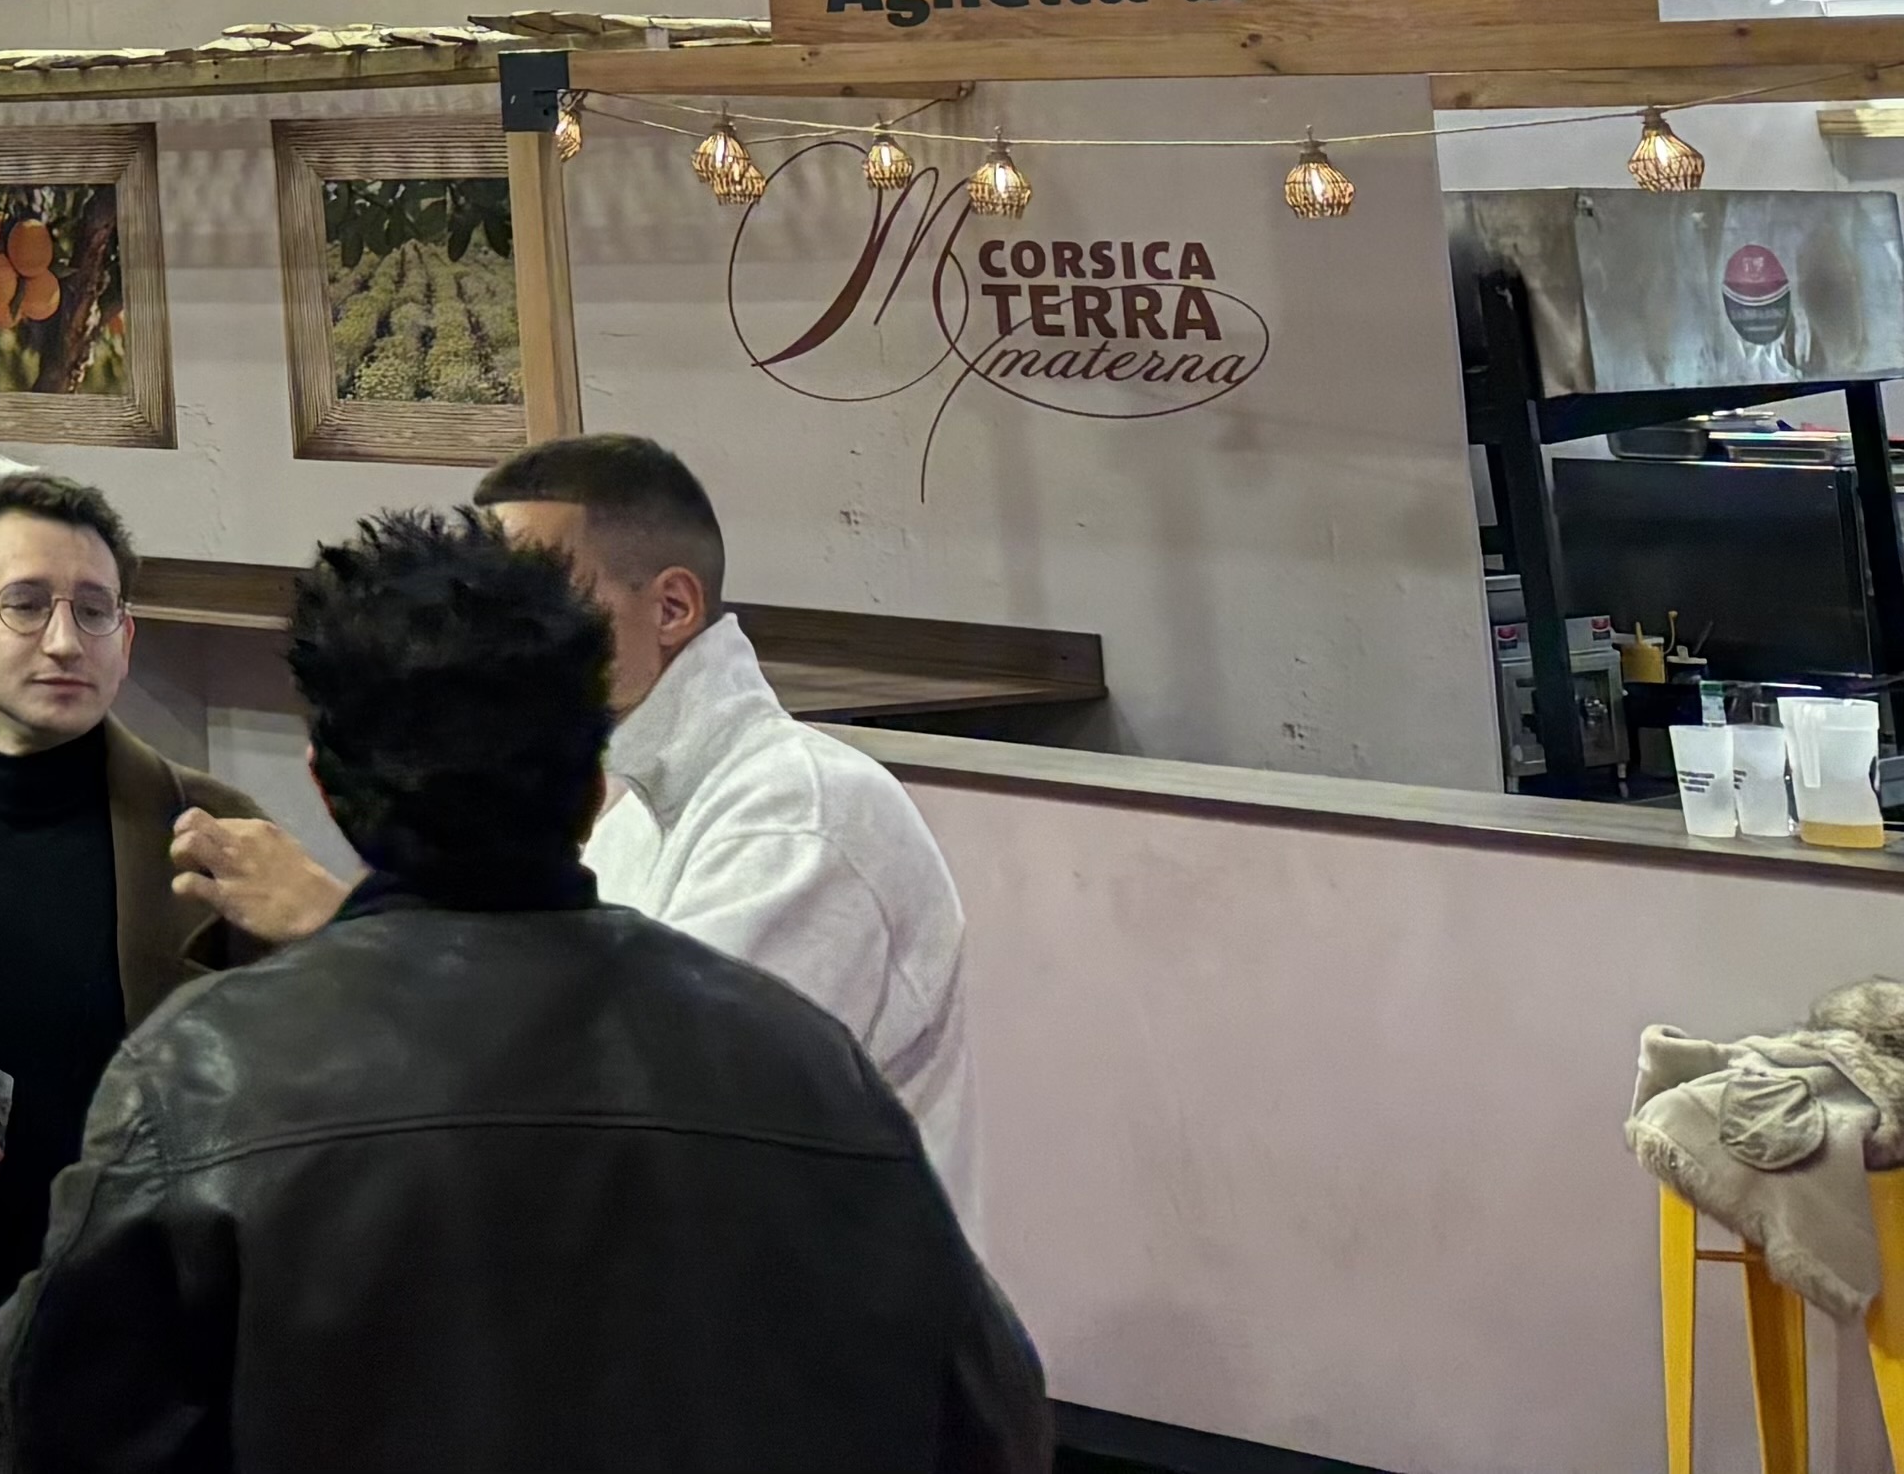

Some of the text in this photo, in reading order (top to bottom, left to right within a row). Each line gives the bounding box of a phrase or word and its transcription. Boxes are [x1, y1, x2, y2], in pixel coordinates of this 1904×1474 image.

[978, 239, 1217, 281] CORSICA
[981, 282, 1222, 341] TERRA
[984, 332, 1249, 388] materna
